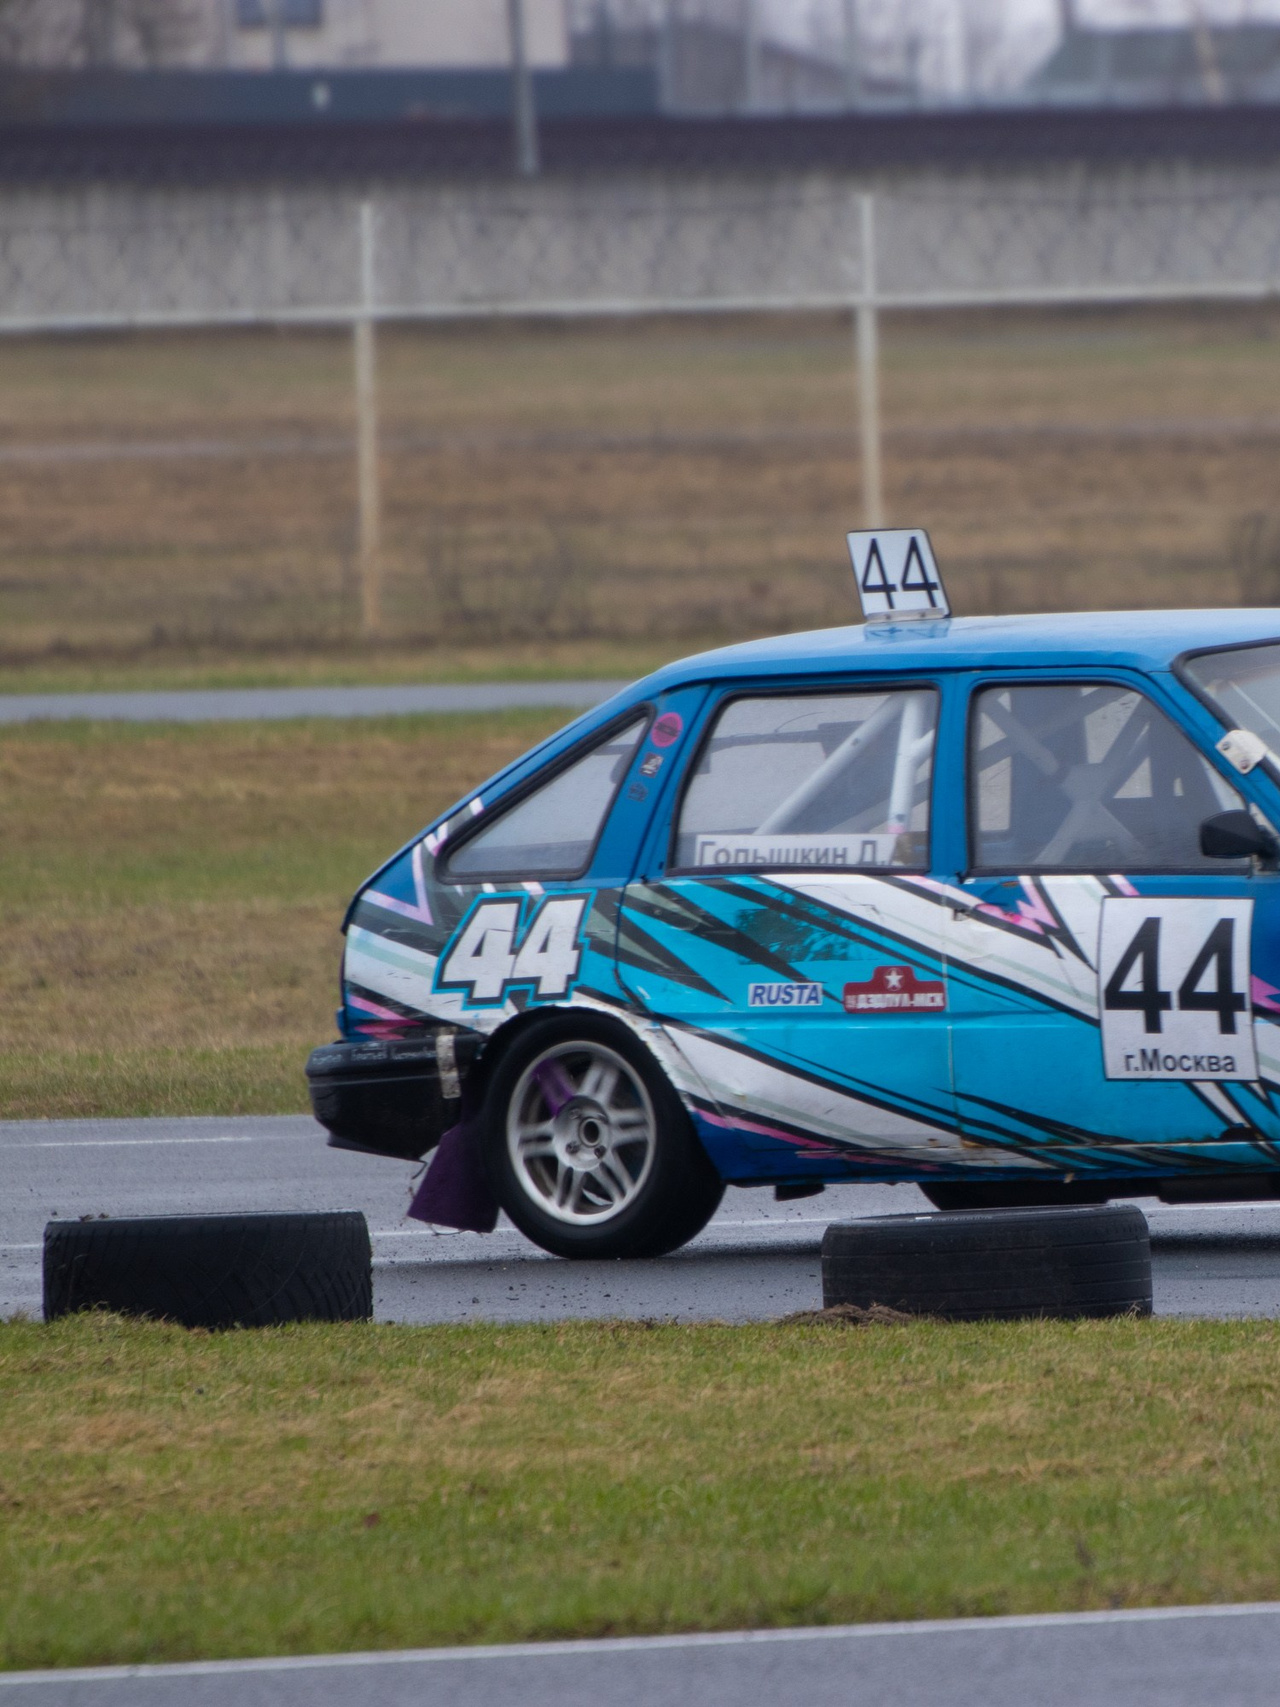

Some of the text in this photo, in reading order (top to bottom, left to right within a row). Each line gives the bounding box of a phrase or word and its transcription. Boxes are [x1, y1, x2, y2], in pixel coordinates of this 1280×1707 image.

[862, 536, 939, 610] 44
[437, 893, 592, 1005] 44
[1104, 916, 1247, 1035] 44
[751, 984, 820, 1005] RUSTA
[1124, 1048, 1237, 1073] г.Москва
